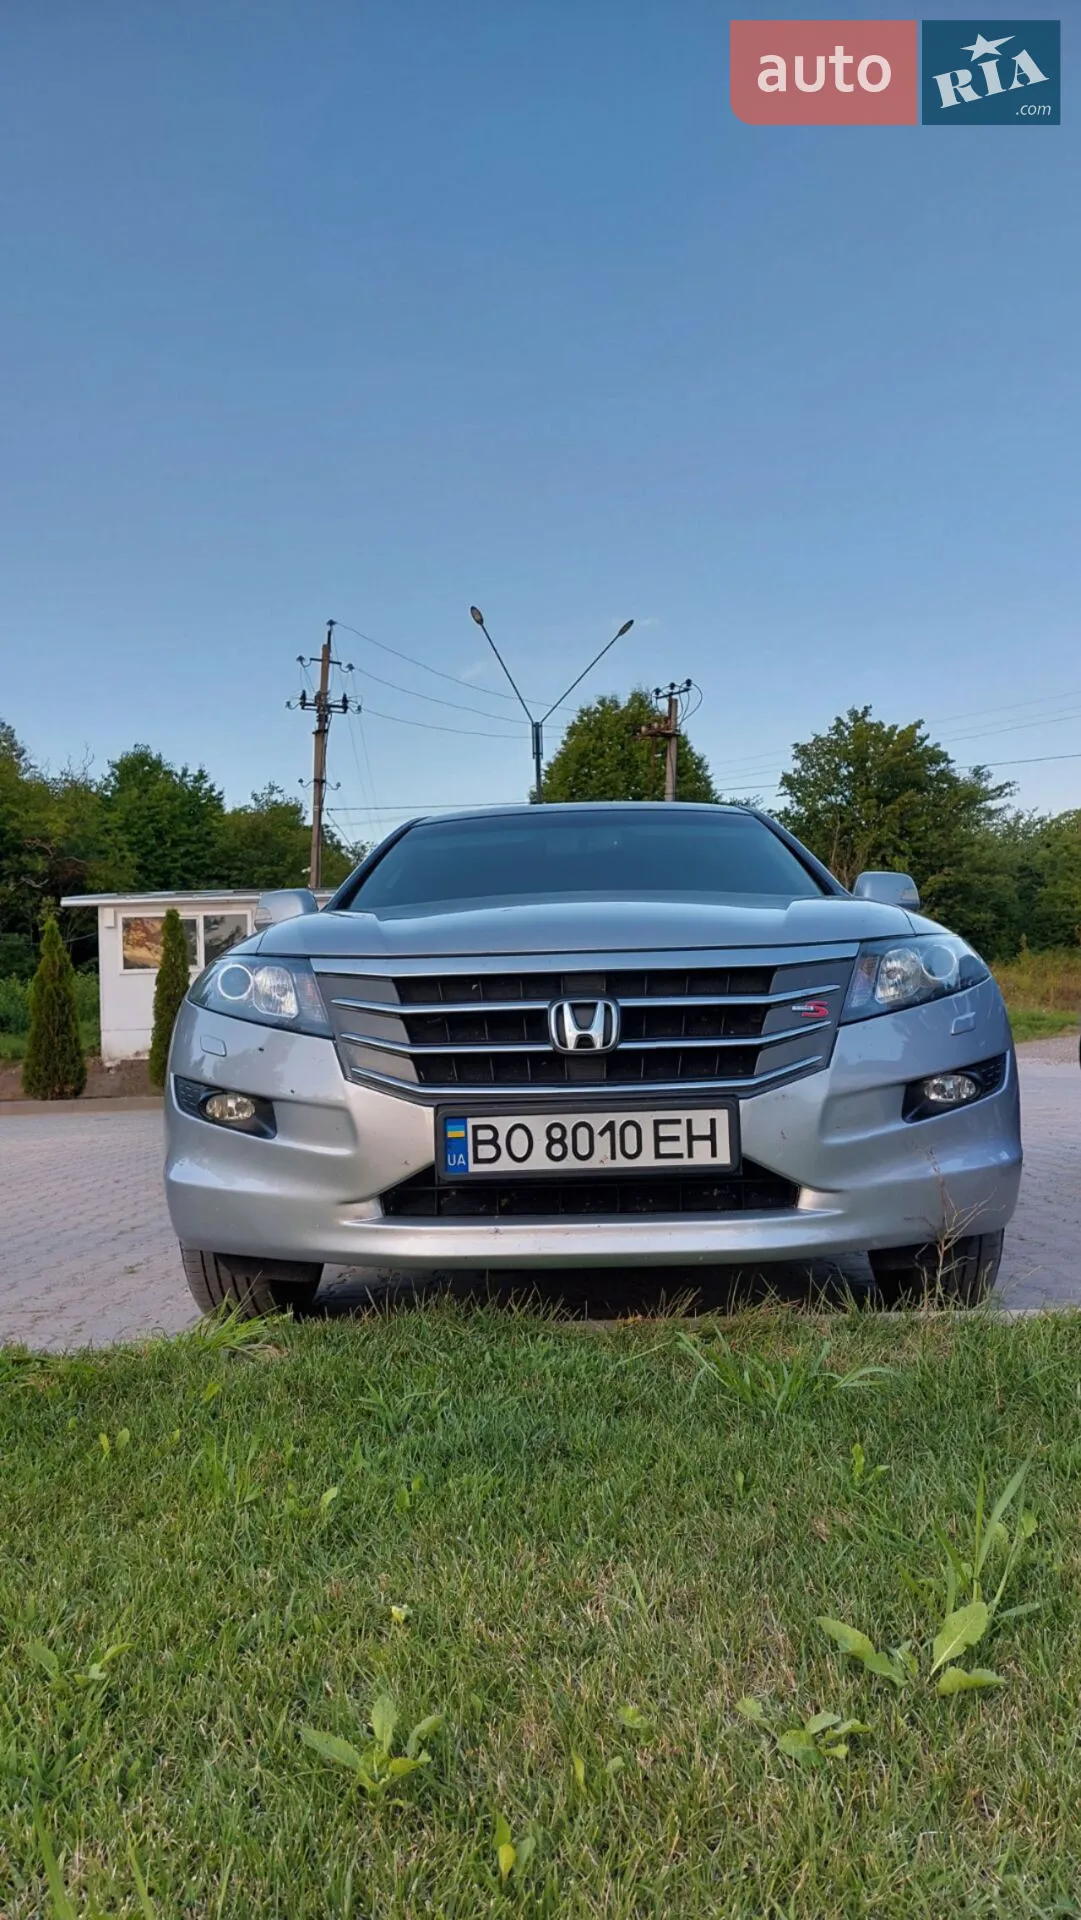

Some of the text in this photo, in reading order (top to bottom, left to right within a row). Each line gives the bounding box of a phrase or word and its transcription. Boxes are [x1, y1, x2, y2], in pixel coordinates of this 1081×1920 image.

[471, 1118, 717, 1164] BO 8010 EH
[447, 1153, 467, 1167] UA
